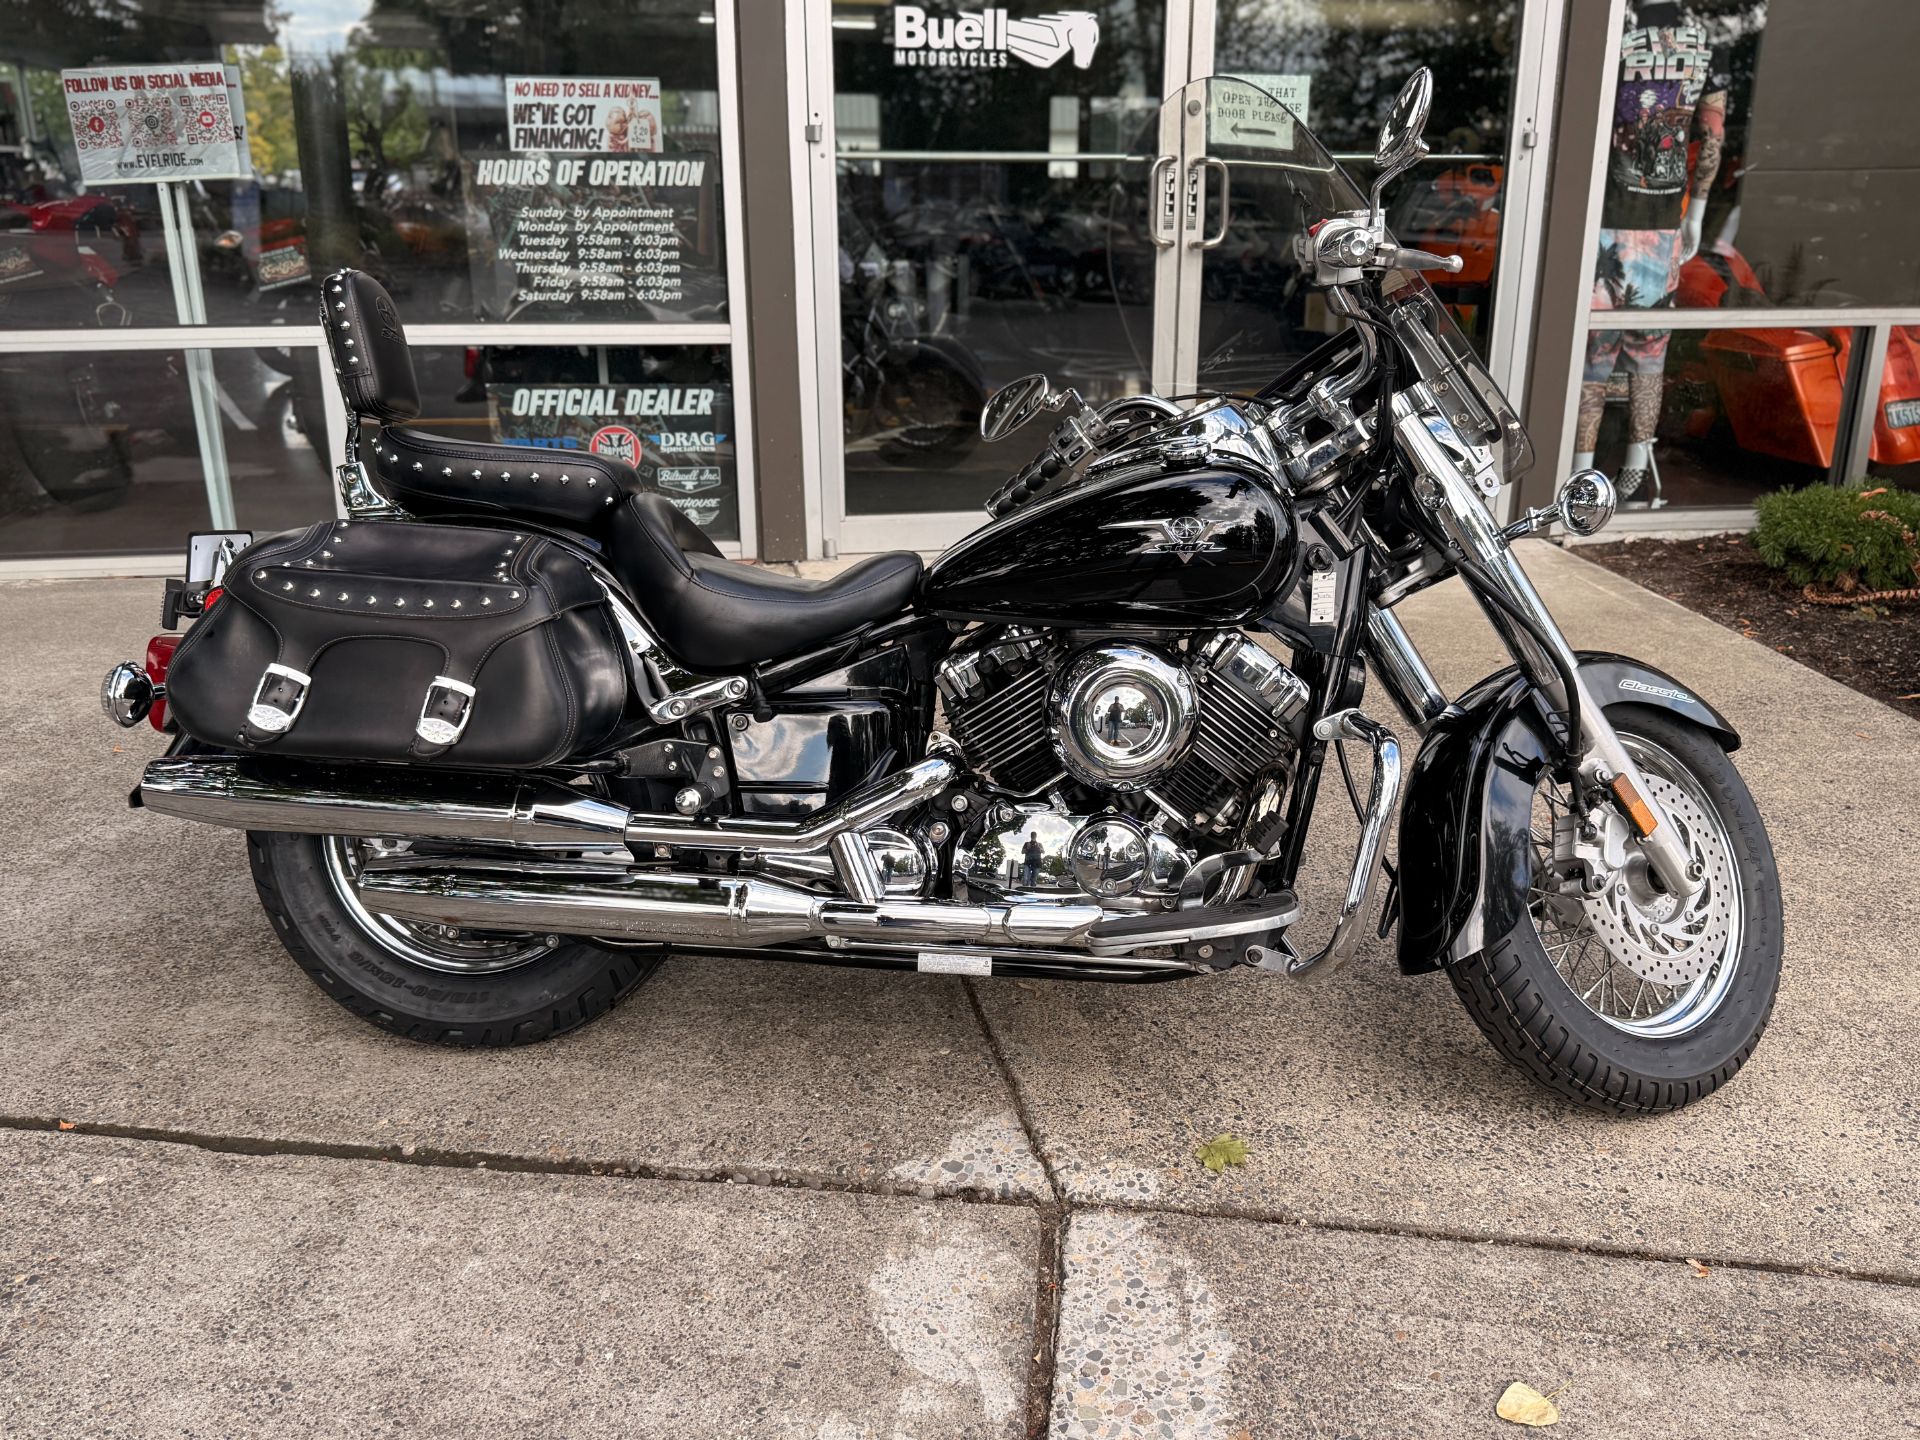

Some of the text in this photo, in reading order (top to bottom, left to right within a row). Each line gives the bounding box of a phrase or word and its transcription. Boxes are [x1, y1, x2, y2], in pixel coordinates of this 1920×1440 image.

[894, 6, 1008, 51] Buell
[894, 51, 1008, 67] MOTORCYCLES
[64, 71, 224, 94] FOLLOW US ON SOCIAL MEDIA
[514, 82, 531, 97] NO
[533, 82, 560, 97] NEED
[562, 83, 576, 97] TO
[579, 83, 601, 98] SELL
[603, 83, 611, 98] A
[1222, 91, 1252, 106] OPEN
[512, 102, 597, 126] WE'VE GOT
[1217, 107, 1247, 120] DOOR
[514, 127, 605, 151] FINANCING!
[476, 159, 705, 187] HOURS OF OPERATION
[1165, 172, 1175, 216] PULL
[1187, 173, 1198, 217] PULL
[521, 206, 675, 220] Sunday by Appointment
[517, 220, 675, 235] Monday by Appointment
[519, 234, 570, 248] Tuesday
[576, 234, 622, 246] 9:58am
[633, 234, 680, 248] 6:03pm
[498, 248, 571, 263] Wednesday
[577, 248, 623, 260] 9:58am
[634, 248, 680, 262] 6:03pm
[515, 262, 572, 276] Thursday
[578, 262, 624, 273] 9:58am
[635, 262, 681, 276] 6:03pm
[533, 275, 573, 290] Friday
[580, 275, 625, 287] 9:58am
[636, 275, 682, 289] 6:03pm
[518, 289, 575, 303] Saturday
[580, 289, 626, 300] 9:58am
[637, 289, 682, 303] 6:03pm
[511, 388, 715, 417] OFFICIAL DEALER
[659, 431, 715, 447] DRAG
